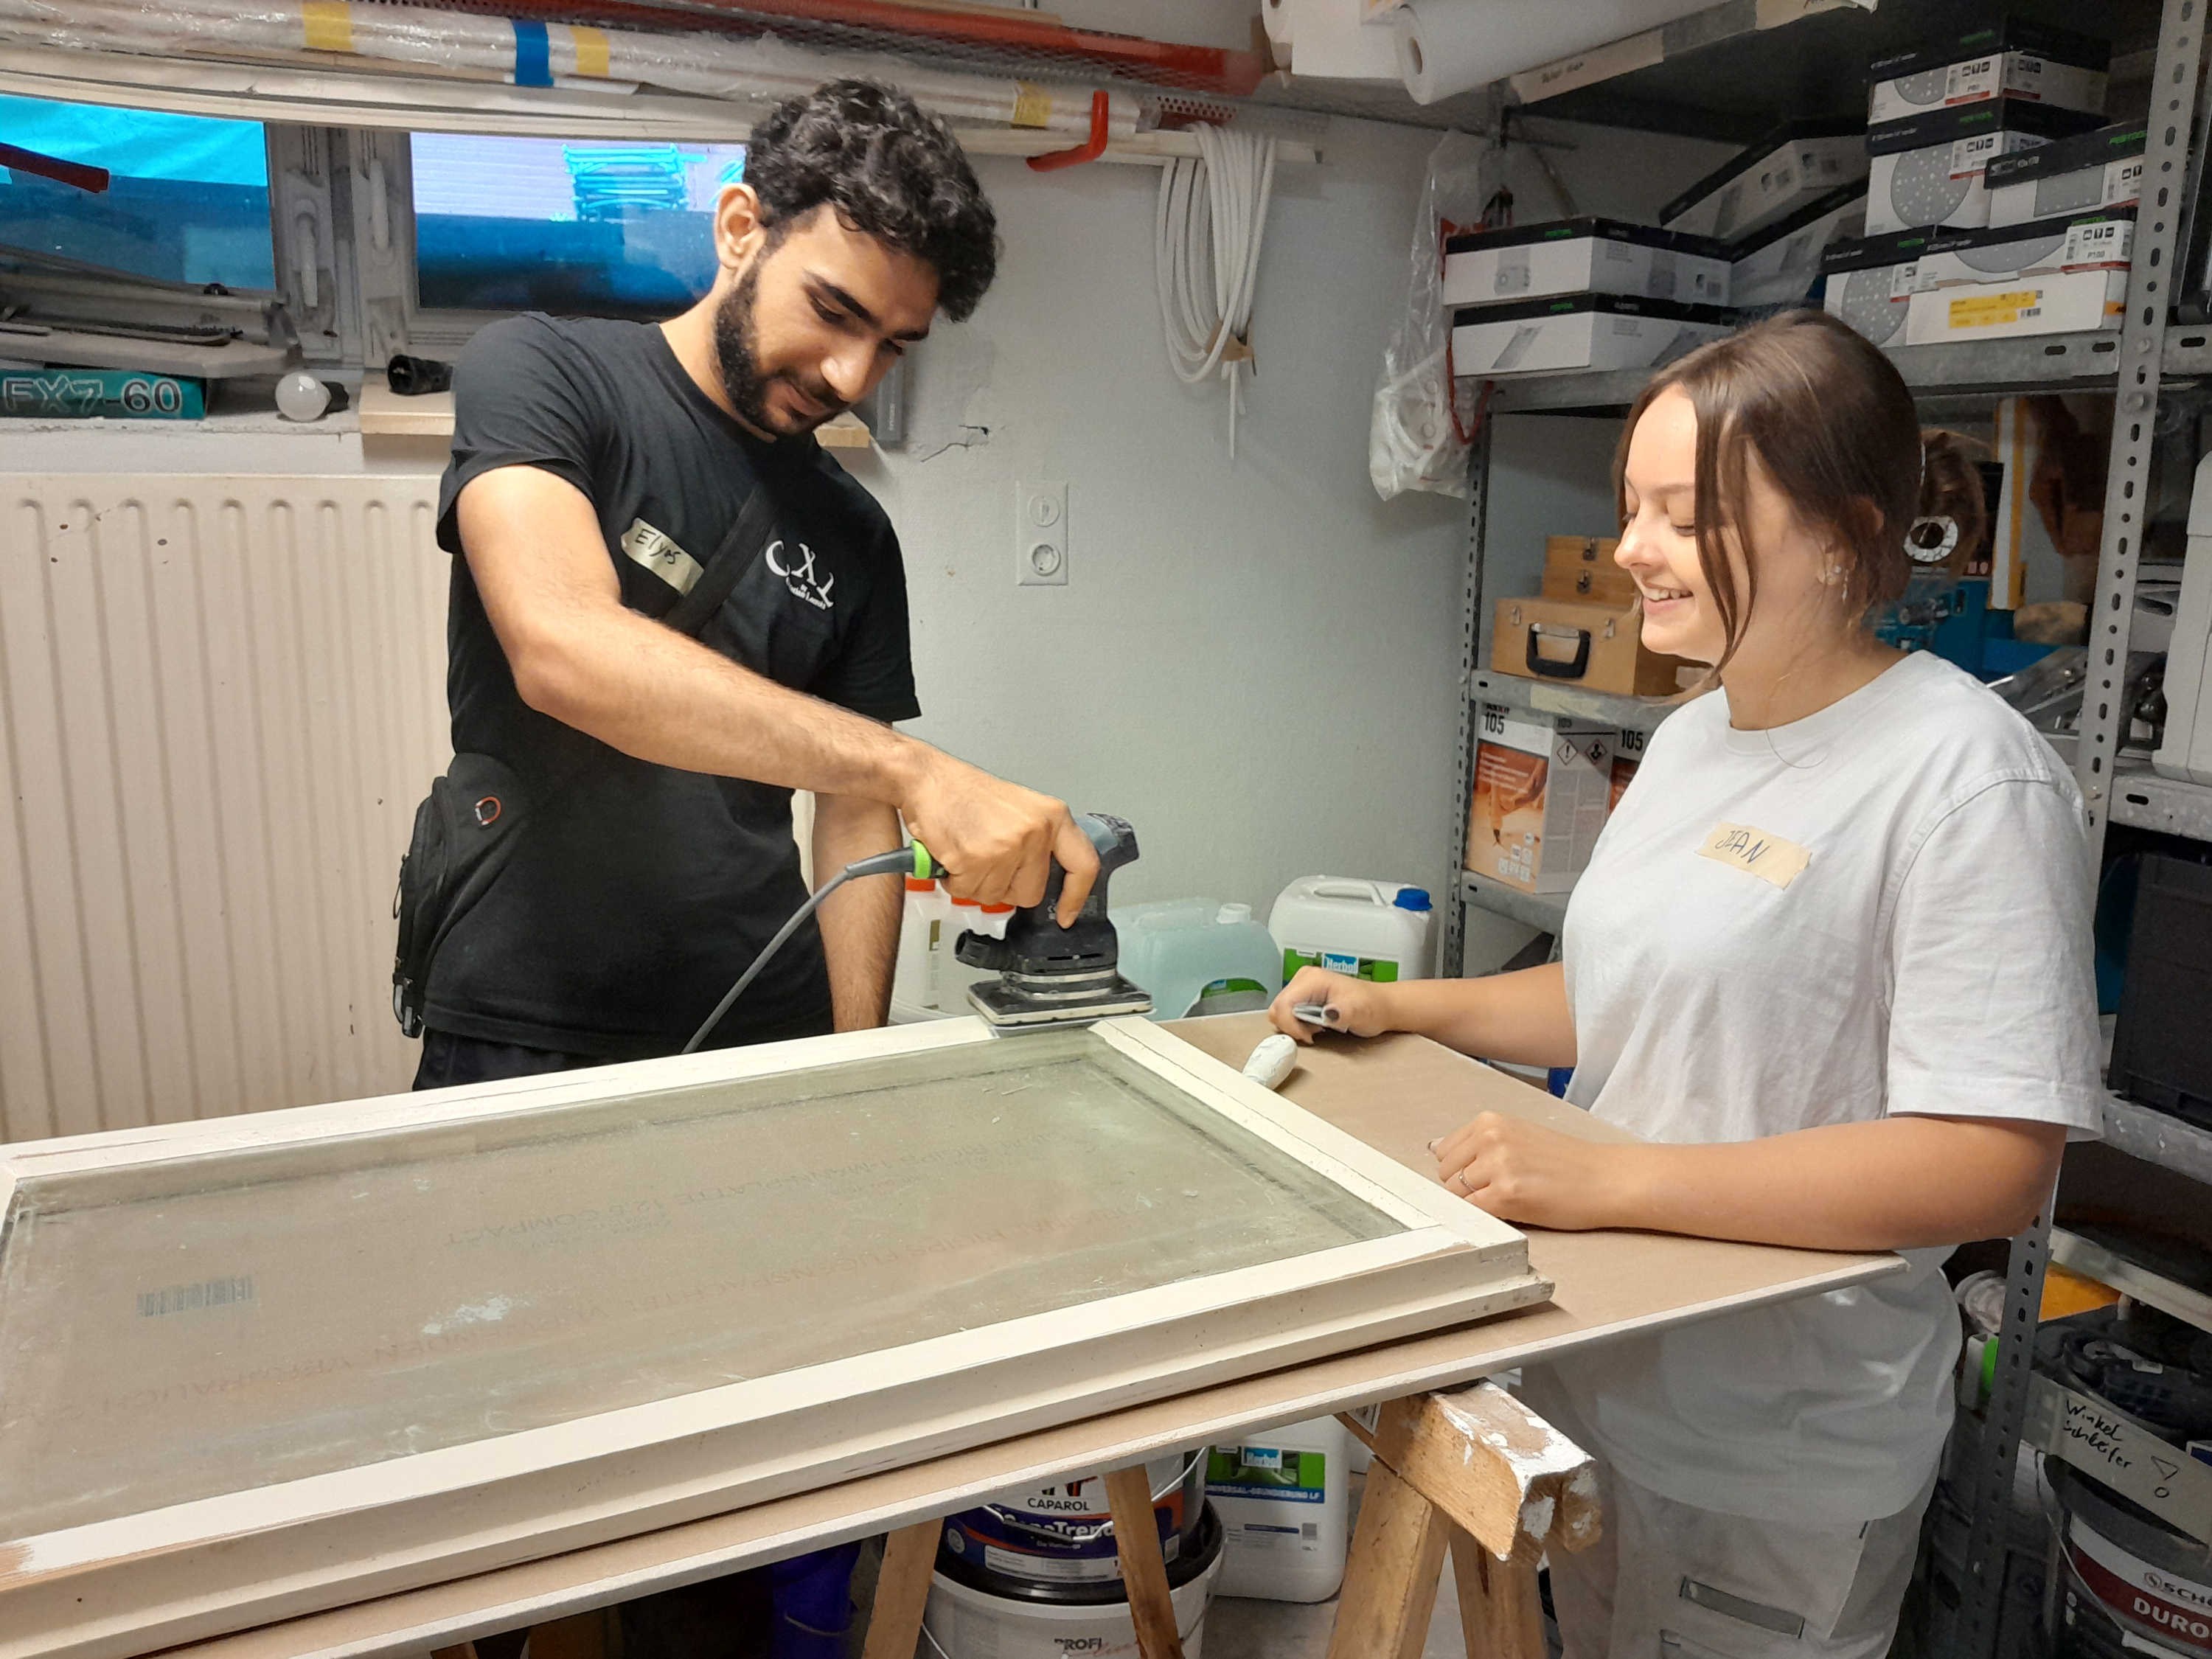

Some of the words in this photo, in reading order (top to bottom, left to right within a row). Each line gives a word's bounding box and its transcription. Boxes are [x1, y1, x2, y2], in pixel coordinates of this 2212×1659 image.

[2, 375, 183, 414] FX7-60
[1485, 712, 1506, 734] 105
[1621, 729, 1644, 751] 105
[1714, 830, 1770, 863] JEAN
[1327, 958, 1357, 974] Herbol
[444, 1209, 599, 1246] COMPACT
[2066, 1399, 2123, 1441] Winkel
[1027, 1498, 1091, 1511] CAPAROL
[2133, 1596, 2212, 1639] DURO
